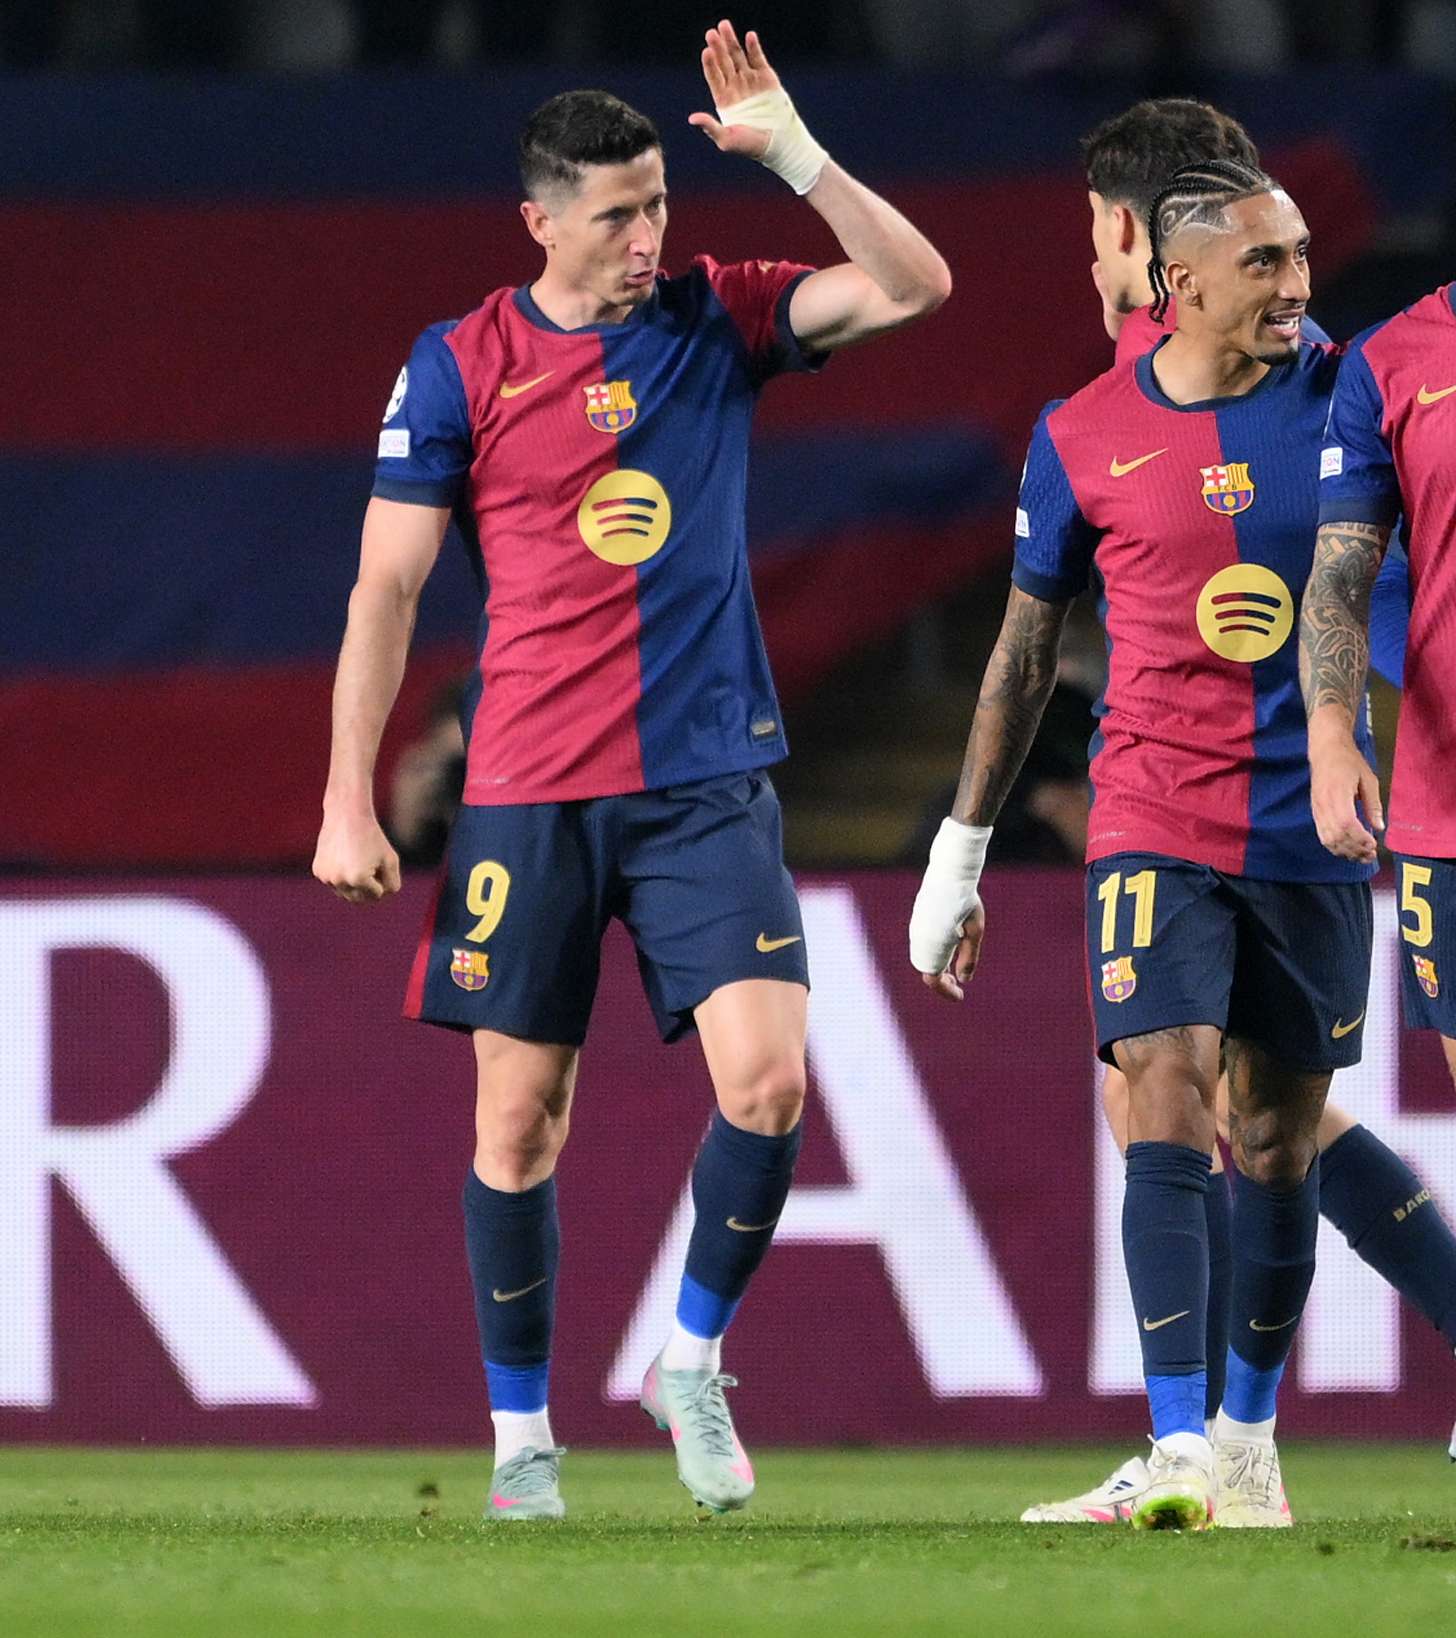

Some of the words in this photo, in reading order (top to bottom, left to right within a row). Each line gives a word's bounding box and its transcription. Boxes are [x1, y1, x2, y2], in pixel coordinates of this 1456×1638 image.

[465, 861, 510, 943] 9
[1098, 870, 1157, 954] 11
[1401, 862, 1433, 947] 5
